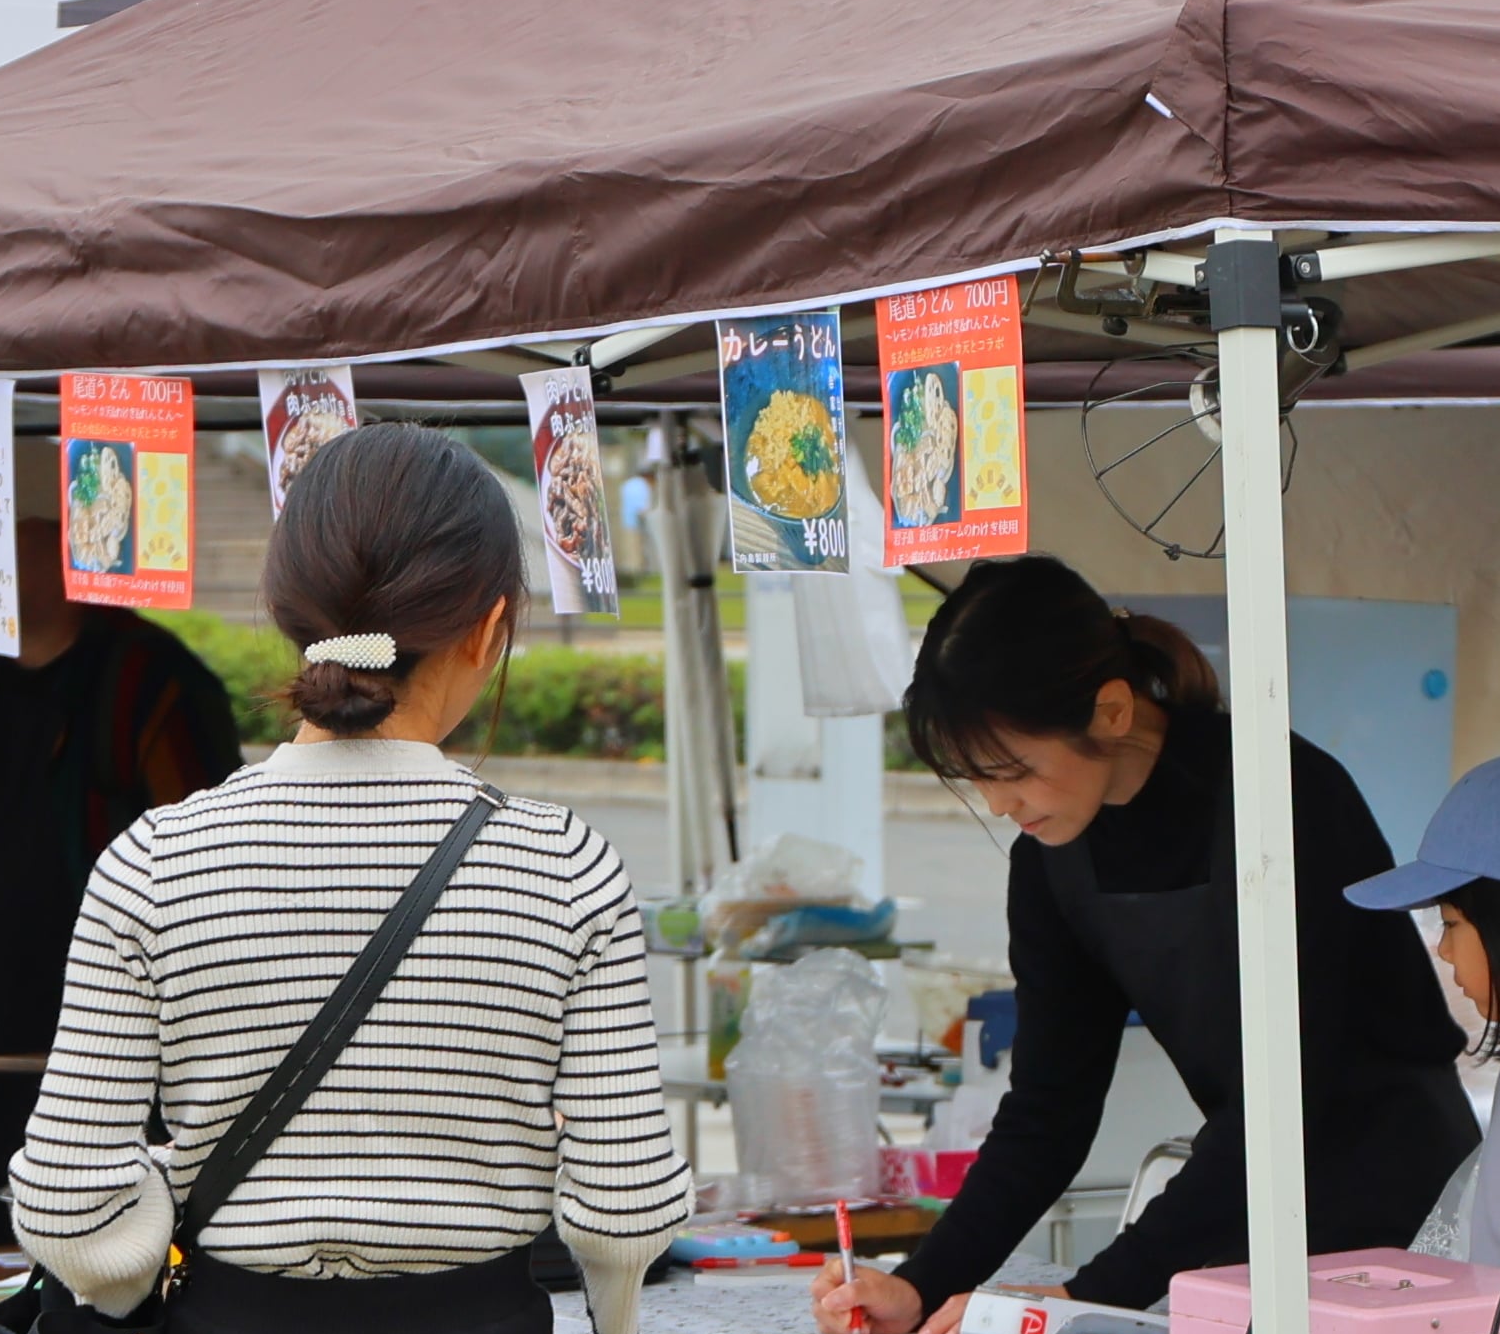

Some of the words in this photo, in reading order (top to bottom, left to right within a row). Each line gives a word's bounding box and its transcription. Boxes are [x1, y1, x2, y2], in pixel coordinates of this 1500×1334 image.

[888, 288, 954, 322] 尾道うどん
[965, 279, 1009, 309] 700円
[723, 323, 836, 362] カレーうどん
[72, 375, 131, 401] 尾道うどん
[139, 379, 184, 405] 700円
[802, 518, 846, 558] ¥800
